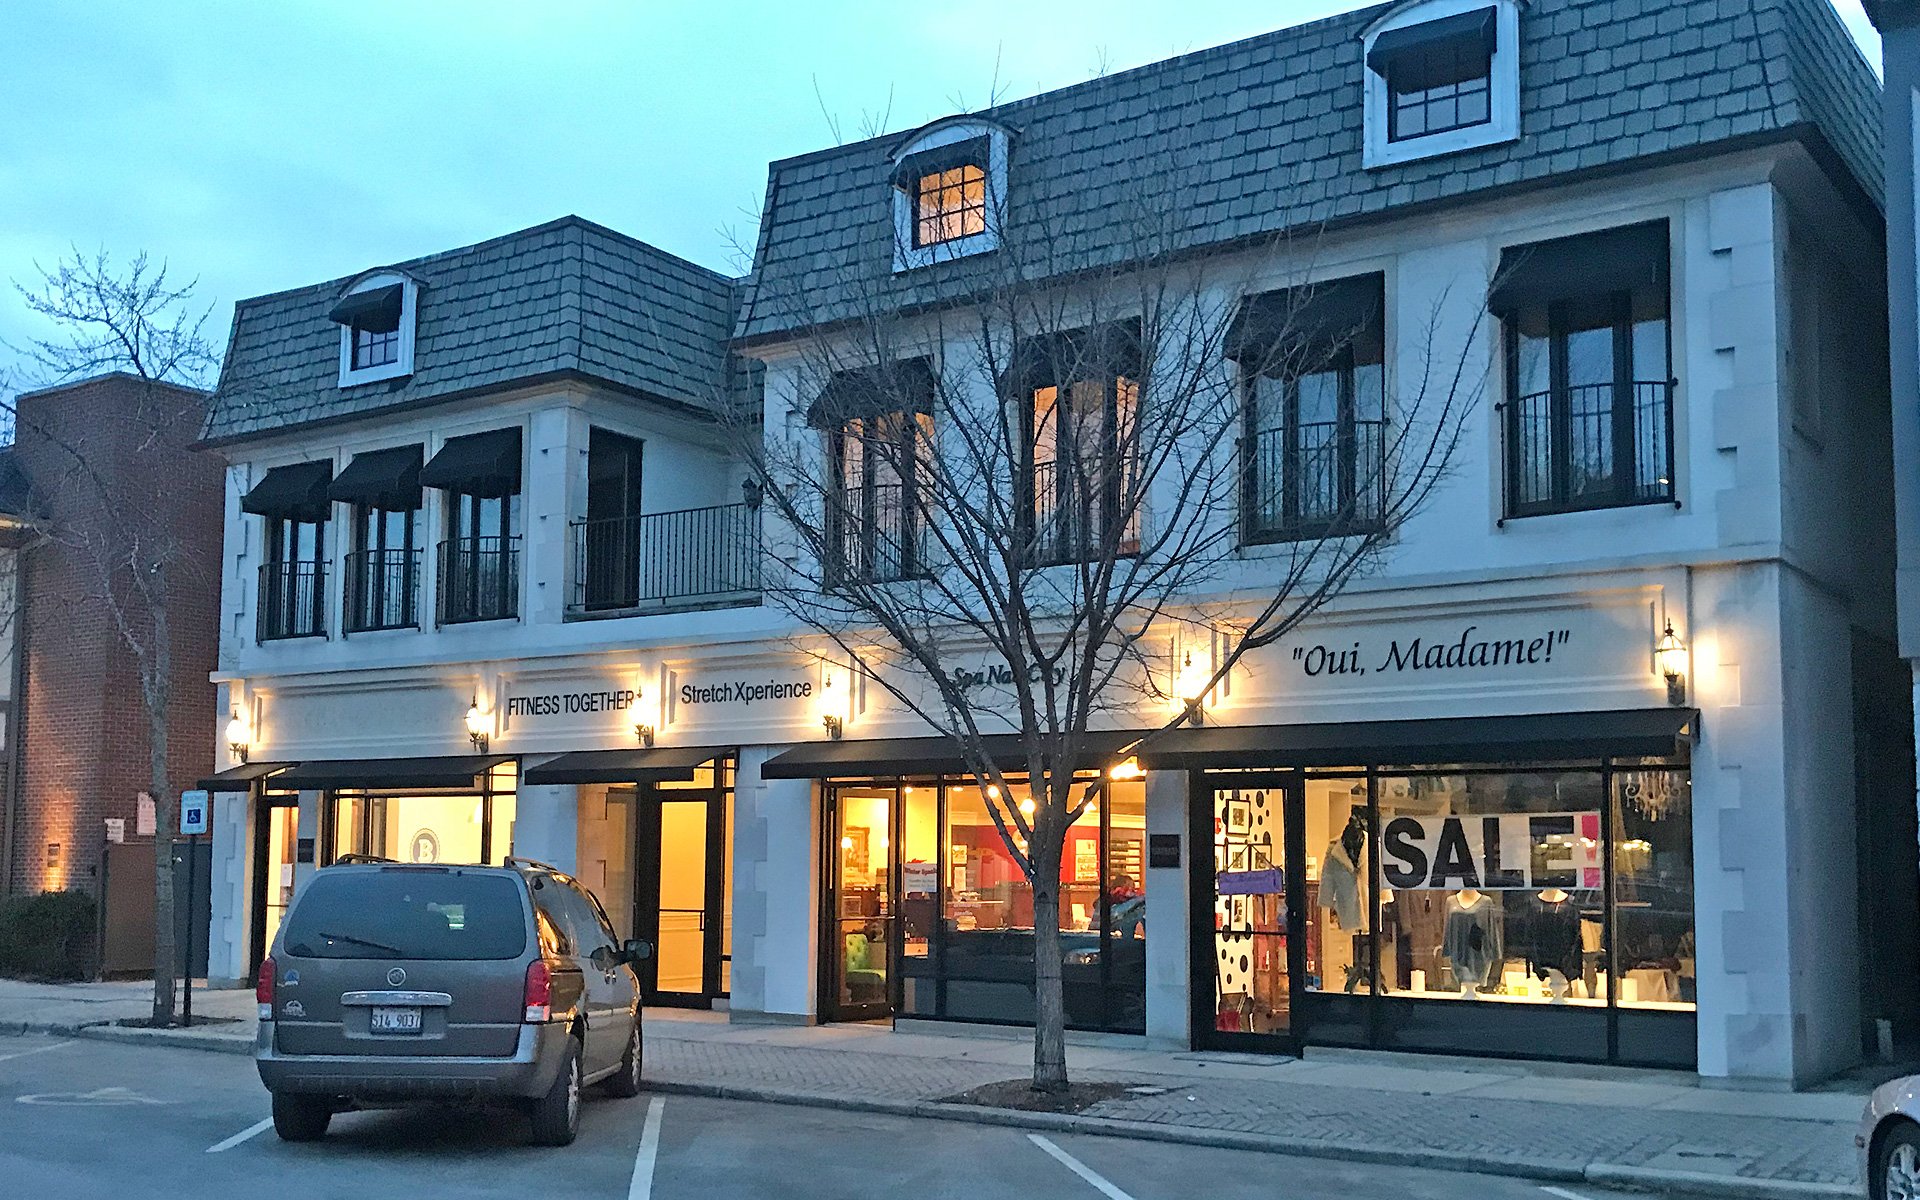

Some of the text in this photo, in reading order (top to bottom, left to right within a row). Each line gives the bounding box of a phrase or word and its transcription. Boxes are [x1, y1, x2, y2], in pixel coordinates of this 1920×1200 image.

[1027, 662, 1066, 687] Cy
[508, 690, 635, 716] FITNESS TOGETHER
[1383, 814, 1601, 889] SALE!
